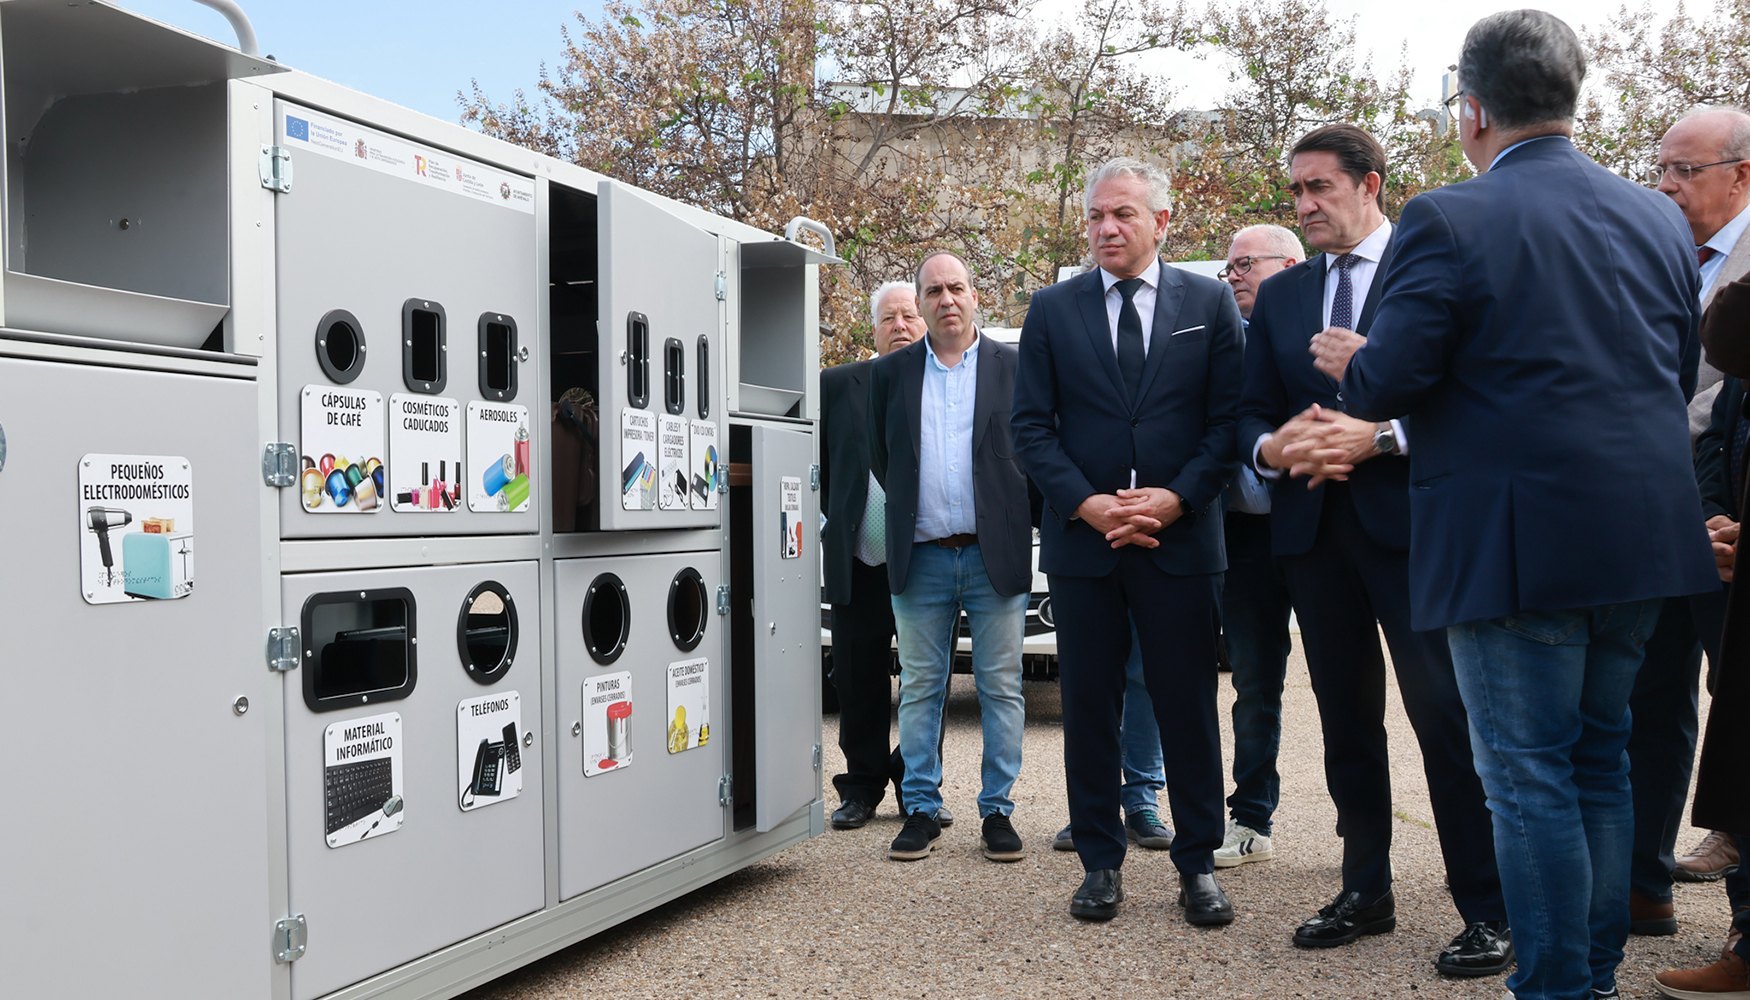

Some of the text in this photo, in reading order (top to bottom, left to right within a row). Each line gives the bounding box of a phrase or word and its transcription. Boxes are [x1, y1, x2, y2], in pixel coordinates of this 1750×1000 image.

[310, 122, 334, 135] Financiado
[316, 131, 329, 140] Unión
[329, 136, 348, 147] Europea
[321, 392, 366, 410] CÁPSULAS
[402, 400, 449, 417] COSMÉTICOS
[327, 411, 362, 427] DE CAFÉ
[479, 408, 518, 423] AEROSOLES
[630, 415, 649, 428] CARTUCHOS
[403, 417, 449, 433] CADUCADOS
[666, 421, 678, 432] CABLES
[662, 434, 684, 446] CARGADORES
[664, 446, 683, 458] ELÉCTRICOS
[111, 461, 164, 481] PEQUEÑOS
[84, 482, 189, 500] ELECTRODOMÉSTICOS
[672, 662, 704, 678] ACEITE DOMÉSTICO
[597, 679, 620, 693] PINTURAS
[591, 690, 626, 706] (ENVASES CERRADOS)
[471, 698, 509, 717] TELÉFONOS
[344, 721, 385, 742] MATERIAL
[336, 736, 393, 761] INFORMÁTICO
